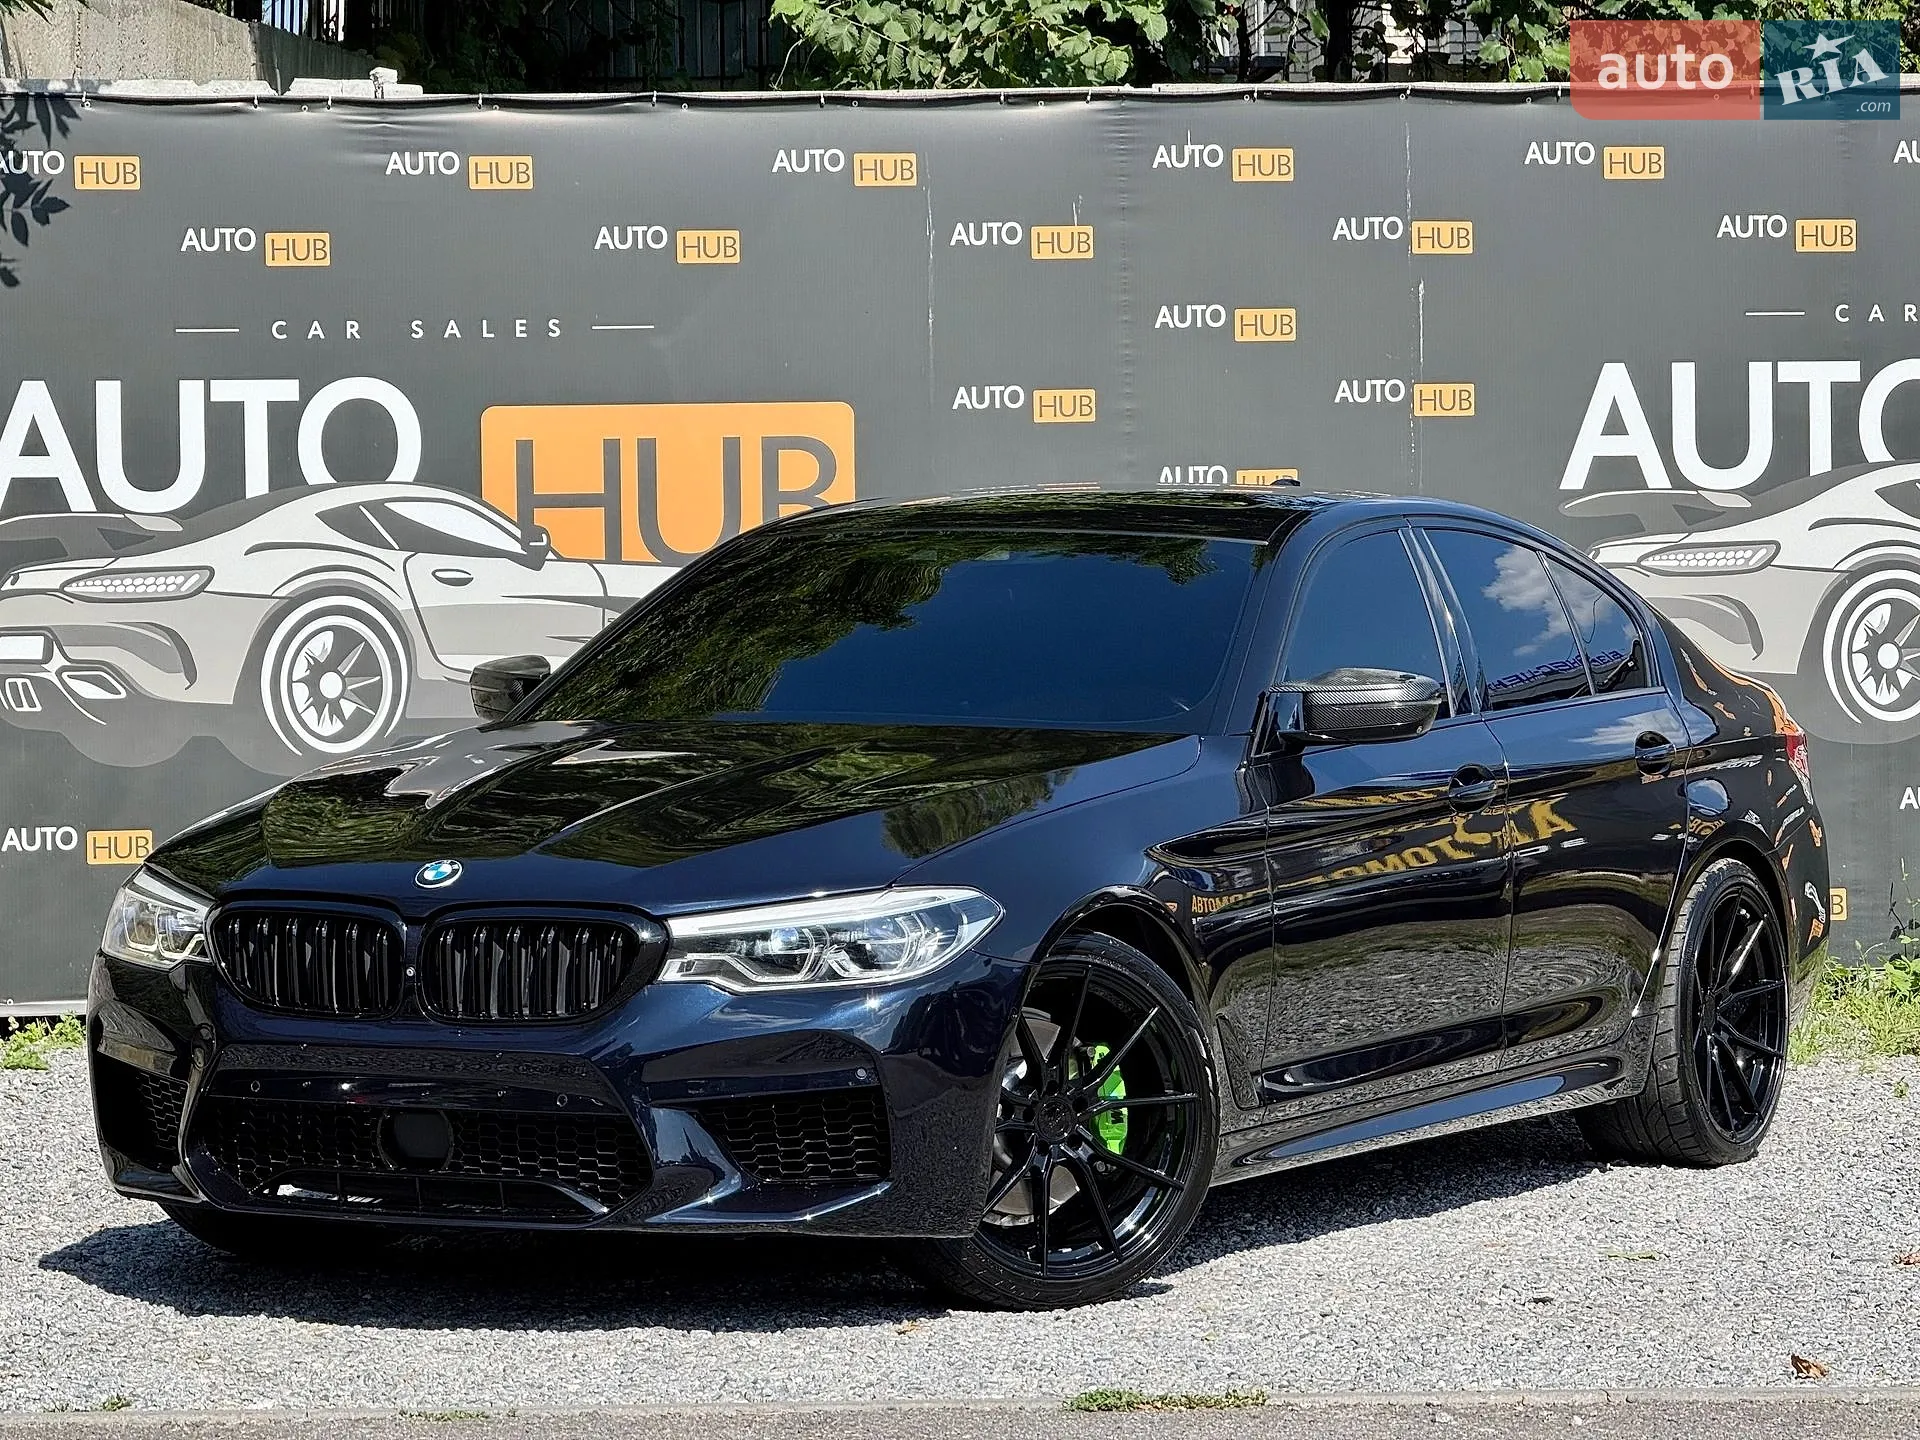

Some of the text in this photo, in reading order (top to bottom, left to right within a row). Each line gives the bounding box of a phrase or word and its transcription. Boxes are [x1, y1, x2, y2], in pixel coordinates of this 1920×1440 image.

[80, 162, 138, 185] HUB
[385, 151, 531, 185] AUTO HUB
[771, 148, 915, 182] AUTO HUB
[1152, 144, 1292, 177] AUTO HUB
[1524, 141, 1663, 175] AUTO HUB
[180, 227, 328, 262] AUTO HUB
[594, 225, 739, 259] AUTO HUB
[949, 221, 1092, 255] AUTO HUB
[1332, 216, 1472, 249] AUTO HUB
[1716, 214, 1855, 247] AUTO HUB
[271, 318, 562, 340] CAR SALES
[1154, 304, 1294, 337] AUTO HUB
[1835, 304, 1919, 323] CAR
[952, 385, 1093, 418] AUTO HUB
[1334, 378, 1473, 412] AUTO HUB
[0, 376, 838, 564] AUTO HUB
[1, 826, 151, 860] AUTO HUB
